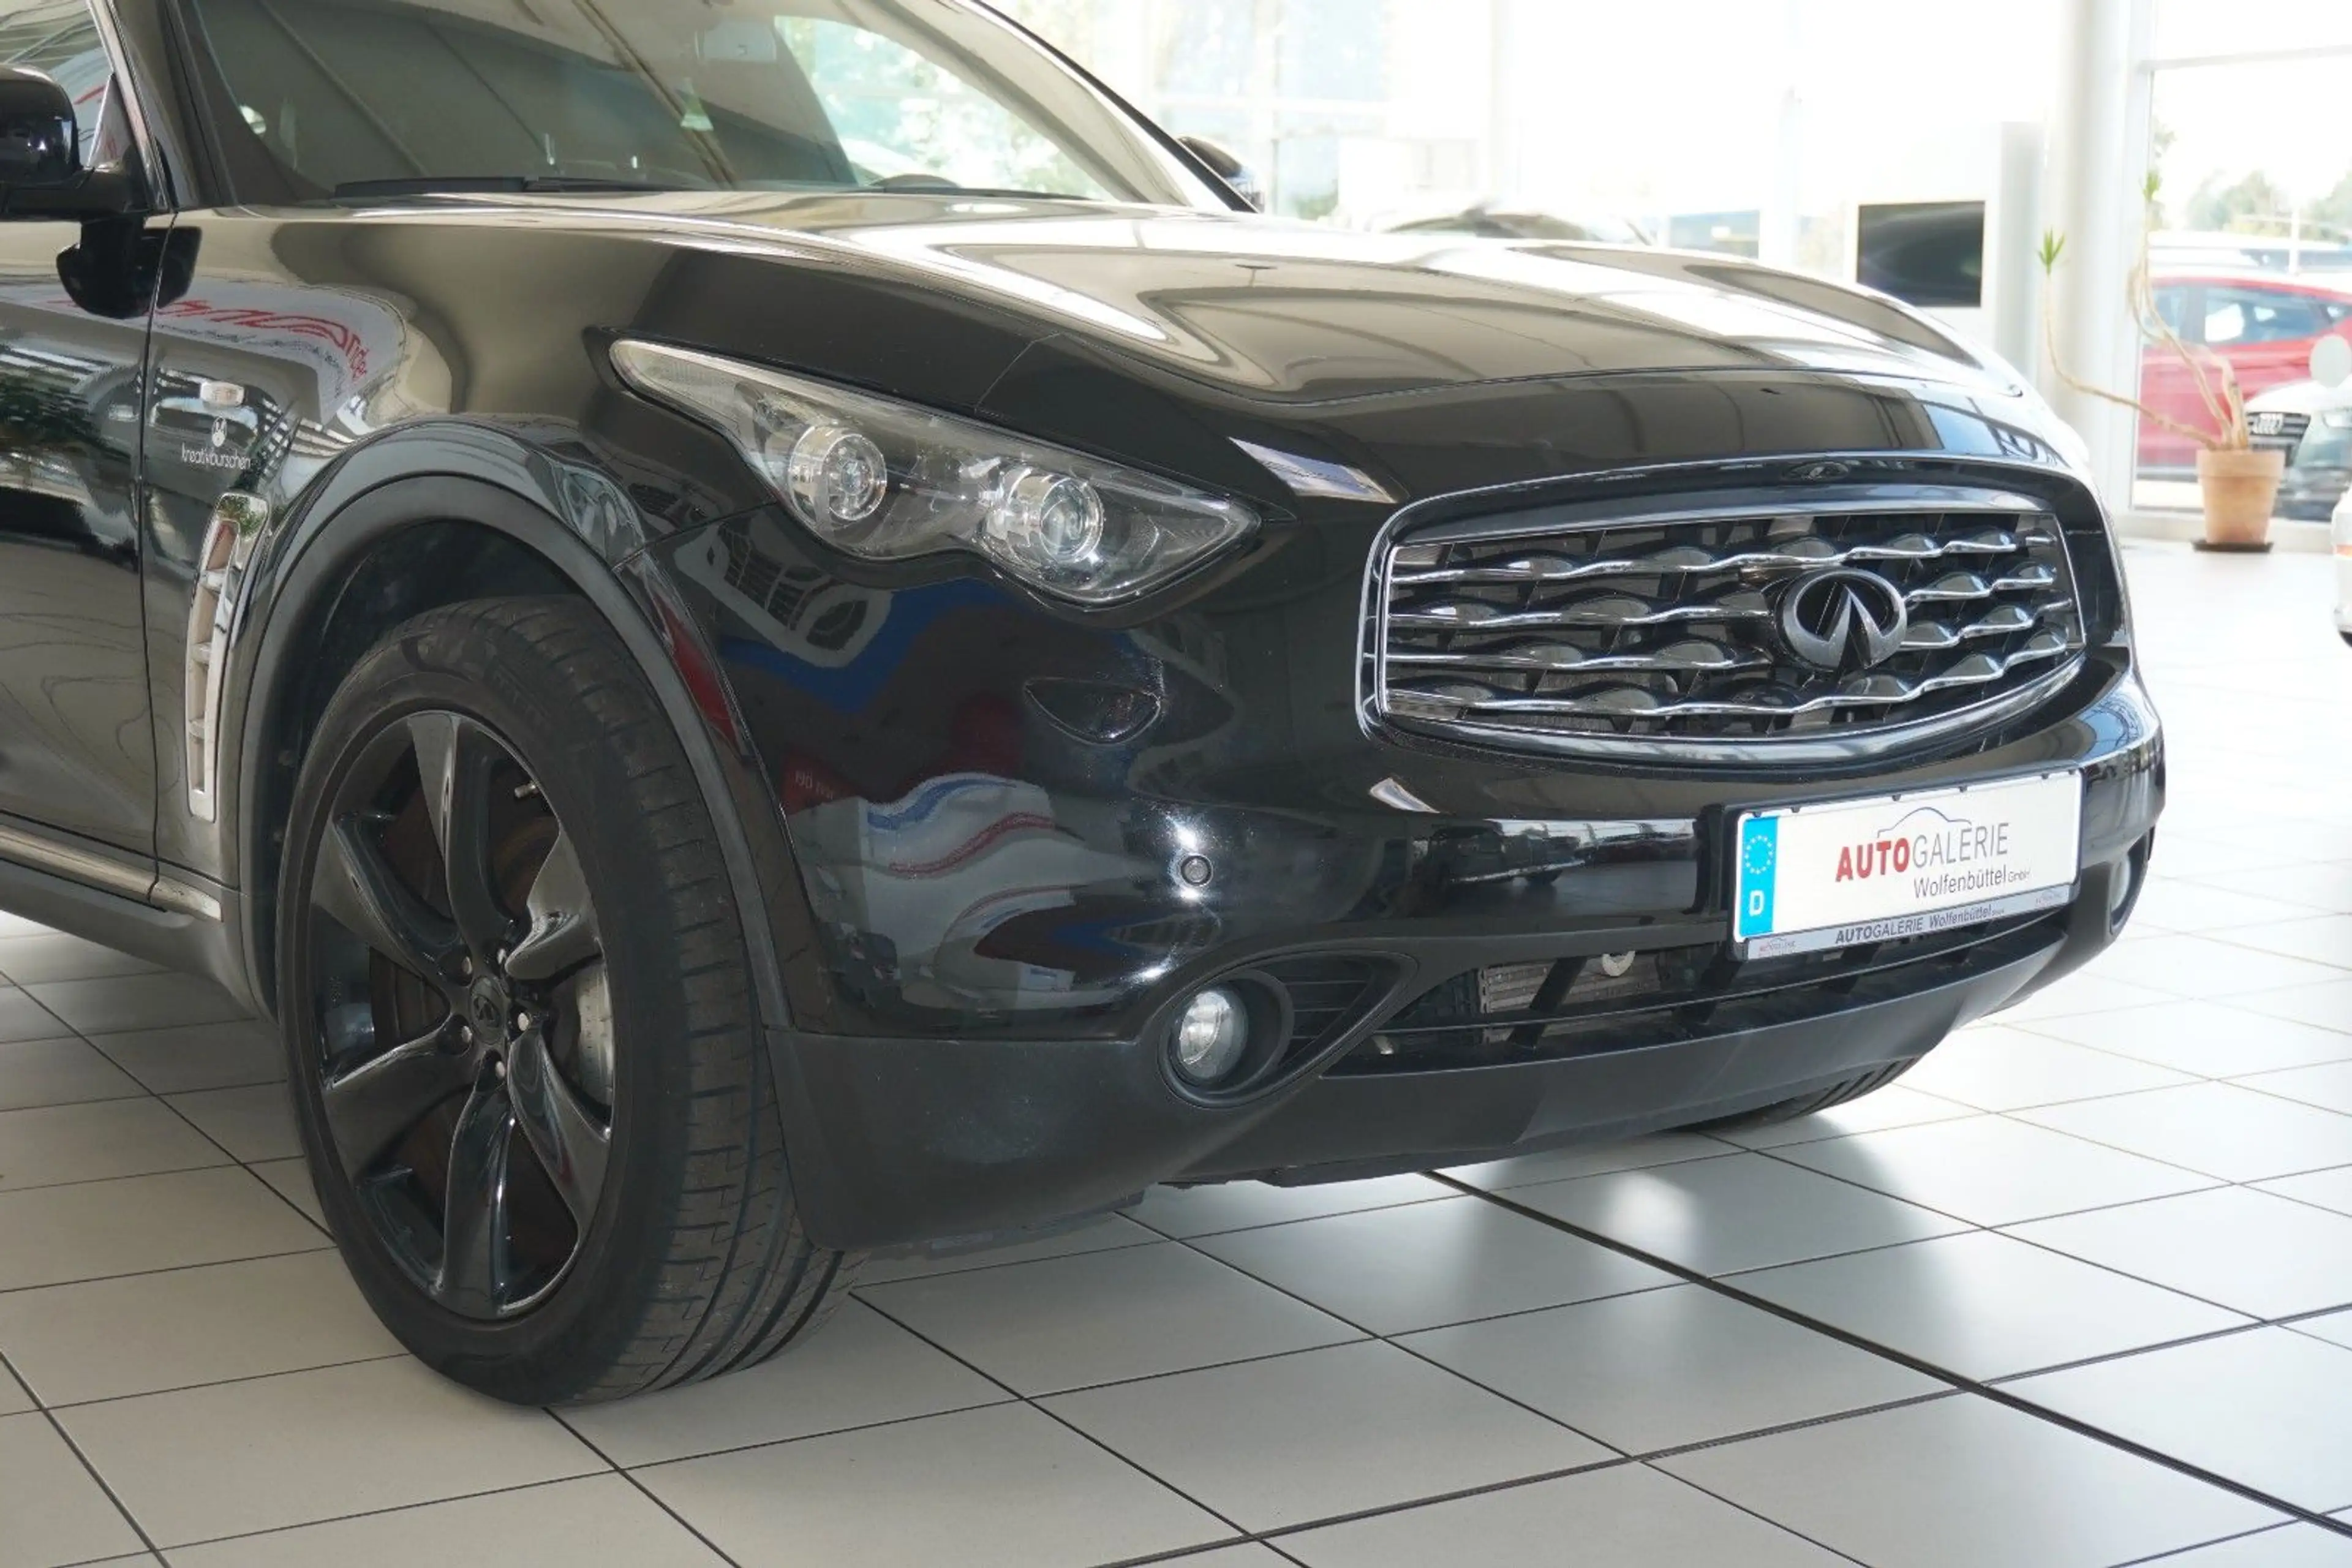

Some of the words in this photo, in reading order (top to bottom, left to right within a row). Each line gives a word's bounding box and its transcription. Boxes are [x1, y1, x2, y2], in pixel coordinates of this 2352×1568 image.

[1836, 822, 2010, 882] AUTOGALERIE
[1914, 864, 2006, 899] Wolfenbüttel
[1749, 890, 1764, 915] D
[1835, 917, 1924, 944] AUTOGALERIE
[1929, 904, 1992, 929] Wolfenbüttel
